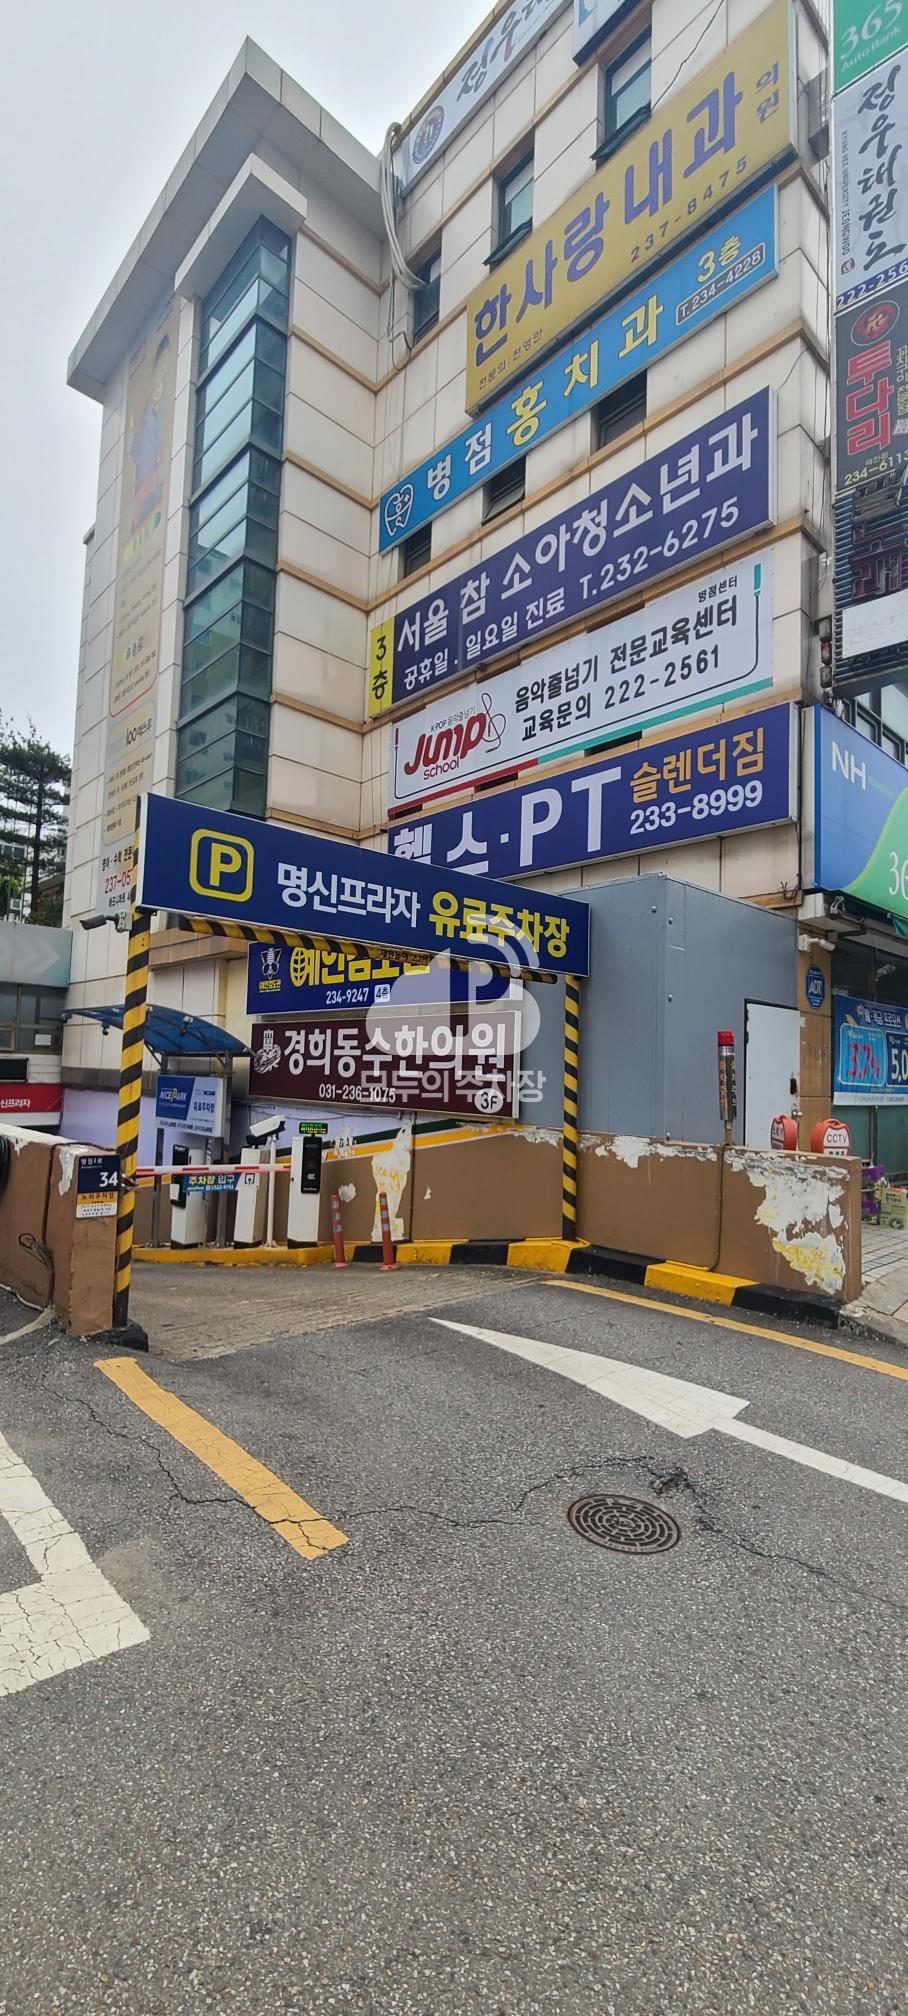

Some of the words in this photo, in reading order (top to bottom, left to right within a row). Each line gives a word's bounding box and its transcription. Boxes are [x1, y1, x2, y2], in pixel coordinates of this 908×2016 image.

[840, 0, 903, 60] 365
[841, 45, 870, 72] Auto
[871, 25, 902, 51] Bank
[857, 64, 907, 271] 정우태권도
[474, 71, 743, 366] 한사랑내과
[756, 62, 780, 124] 의원
[630, 159, 747, 263] 237-8475
[841, 209, 849, 256] JEONGWOO
[680, 252, 763, 316] T.234-4228
[698, 235, 742, 284] 3층
[837, 259, 908, 309] 222-256
[427, 422, 492, 500] 병점
[507, 294, 664, 446] 홍치과
[846, 340, 894, 455] 투다리
[398, 598, 449, 653] 서울
[460, 573, 490, 625] 참
[502, 413, 758, 600] 소아청소년과
[404, 650, 449, 691] 공휴일
[465, 611, 518, 660] 일요일
[525, 586, 565, 630] 진료
[579, 497, 739, 601] T.232-6275
[698, 575, 738, 602] 병점센터
[373, 635, 388, 700] 3층
[515, 655, 599, 713] 음악줄넘기
[610, 596, 738, 674] 전문교육센터
[521, 696, 591, 741] 교육문의
[605, 646, 720, 710] 222-2561
[423, 756, 460, 780] school
[630, 727, 764, 804] 슬렌더짐
[832, 741, 866, 790] NH
[630, 781, 763, 834] 233-8999
[209, 844, 242, 886] P
[277, 862, 421, 928] 명신프라자
[429, 891, 570, 957] 유료주차장
[326, 988, 369, 1004] 234-9247
[376, 986, 389, 999] 4층
[809, 979, 822, 995] ADT
[284, 1023, 506, 1082] 경희동수한의원
[319, 1084, 396, 1103] 031-236-1075
[481, 1092, 498, 1109] 3F
[826, 1133, 847, 1144] CCTV
[99, 1171, 119, 1188] 34
[189, 1175, 215, 1186] 주차장
[218, 1174, 235, 1185] 입구
